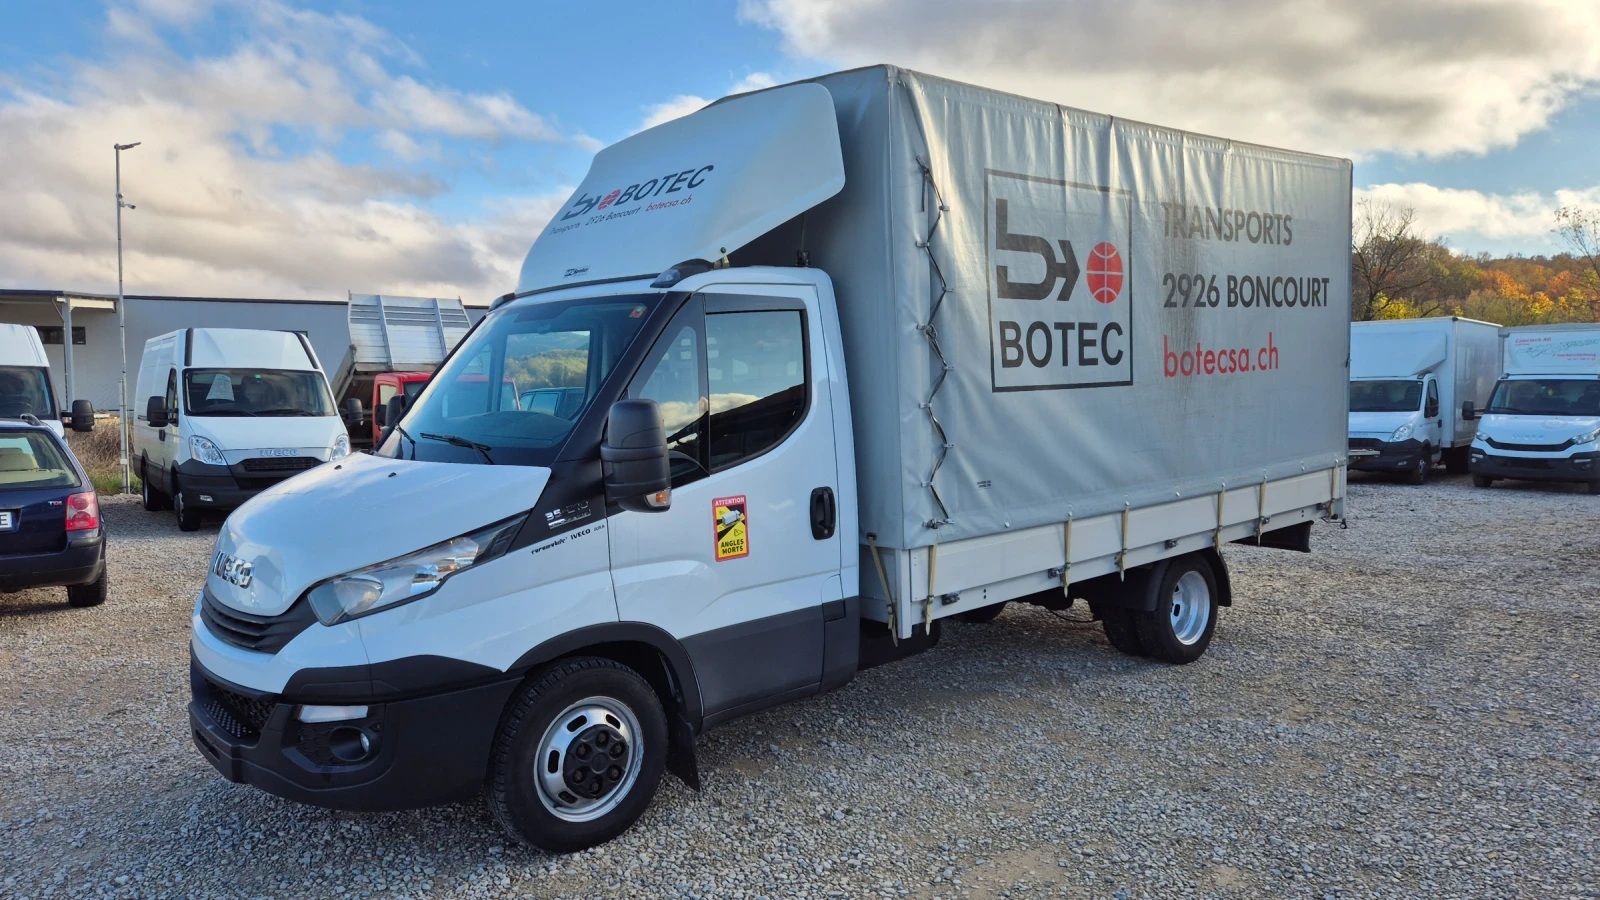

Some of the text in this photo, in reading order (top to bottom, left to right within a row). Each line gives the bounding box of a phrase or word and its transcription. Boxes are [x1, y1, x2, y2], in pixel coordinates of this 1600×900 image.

[613, 165, 714, 206] BOTEC
[585, 211, 606, 226] 2926
[605, 206, 641, 222] Boncourt
[645, 194, 692, 212] botecsa.ch
[1161, 202, 1293, 246] TRANSPORTS
[1162, 273, 1330, 308] 2926 BONCOURT
[998, 321, 1124, 368] BOTEC
[1162, 332, 1279, 378] botecsa.ch
[259, 449, 299, 457] IVECO
[715, 496, 744, 506] ATTENTION
[570, 528, 591, 540] IVECO
[720, 539, 744, 548] ANGLES
[722, 545, 743, 555] MORTS
[212, 550, 255, 589] IVECO
